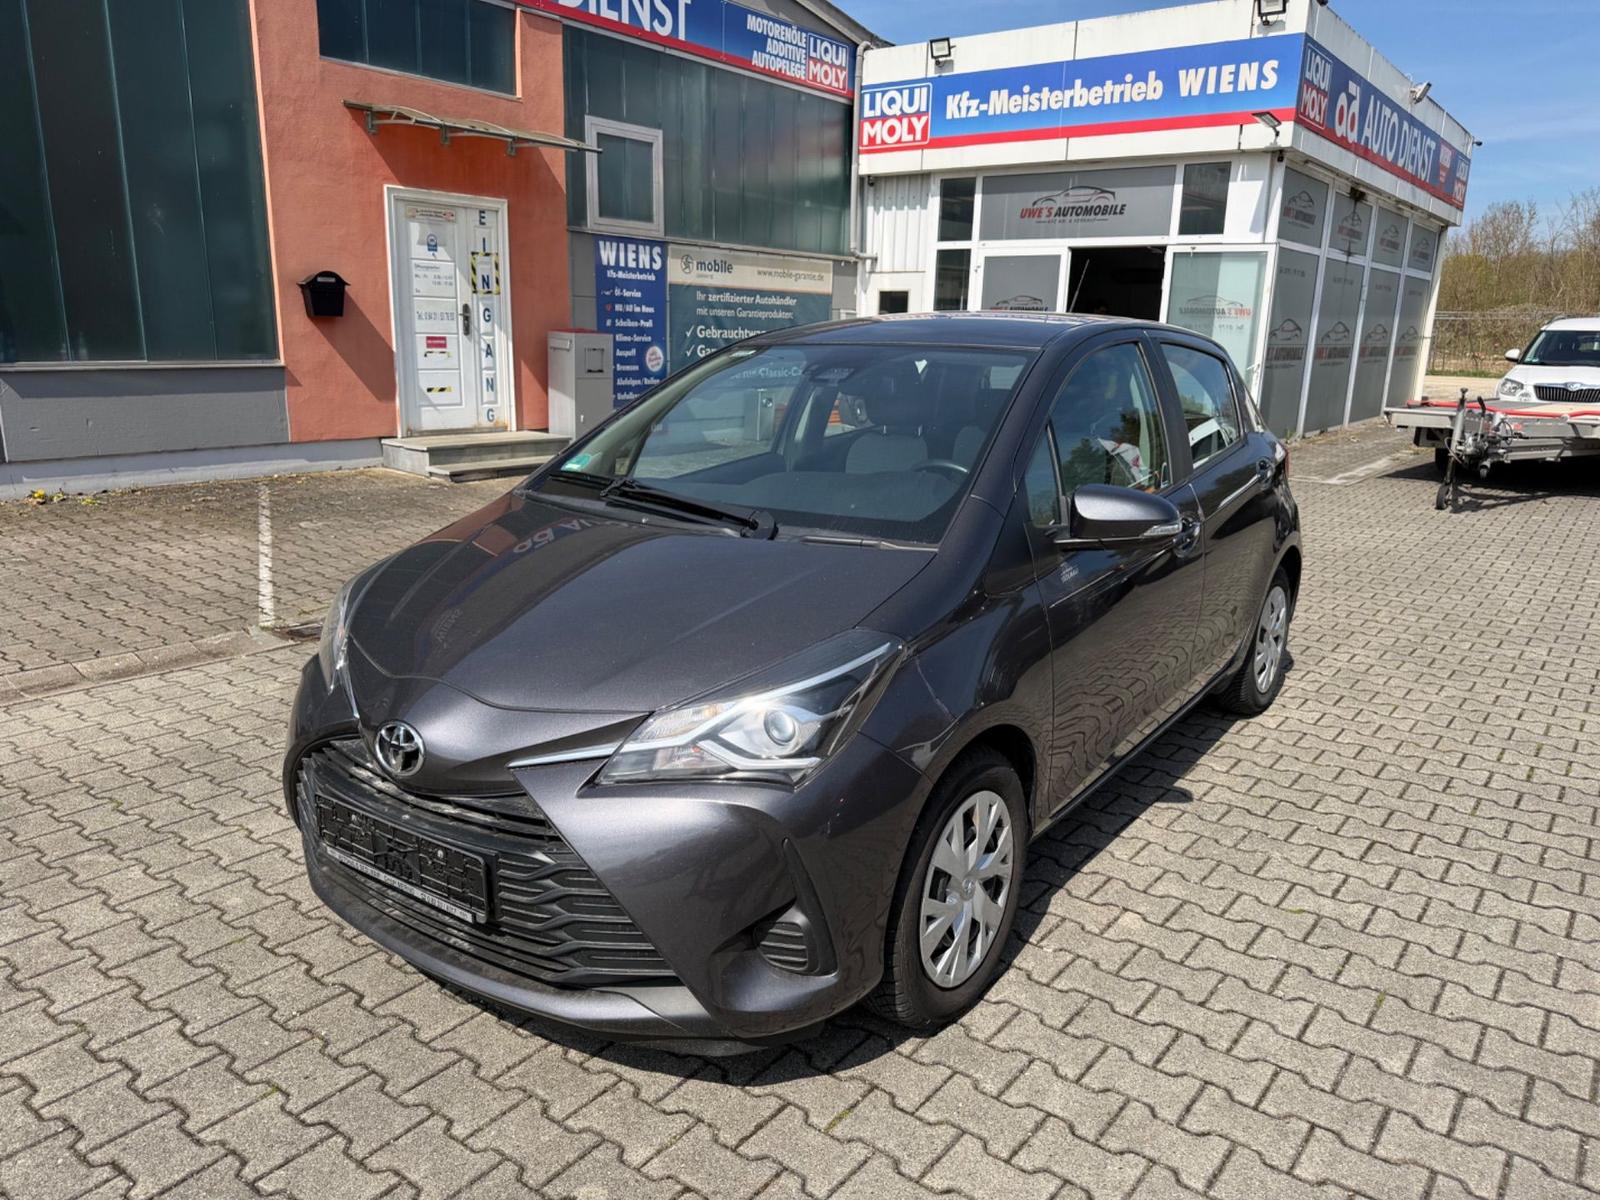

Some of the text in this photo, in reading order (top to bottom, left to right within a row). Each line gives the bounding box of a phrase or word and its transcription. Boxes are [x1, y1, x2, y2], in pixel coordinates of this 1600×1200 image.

[746, 14, 807, 48] MOTORENÖLE
[751, 50, 806, 80] AUTOPFLEGE
[766, 38, 806, 64] ADDITIVE
[809, 37, 847, 67] LIQUI
[808, 60, 847, 89] MOLY
[1305, 49, 1331, 90] LIQUI
[863, 87, 928, 117] LIQUI
[945, 59, 1280, 120] Kfz-Meisterbetrieb WIENS
[1300, 84, 1328, 124] MOLY
[862, 115, 928, 145] MOLY
[1361, 94, 1399, 162] AUTO
[1397, 122, 1436, 183] DIENST
[1054, 203, 1127, 218] AUTOMOBILE
[598, 240, 662, 271] WIENS
[696, 258, 733, 274] mobile
[696, 290, 798, 306] Ihr zertifizierter Autohändler
[696, 306, 708, 316] mit
[709, 308, 735, 317] unseren
